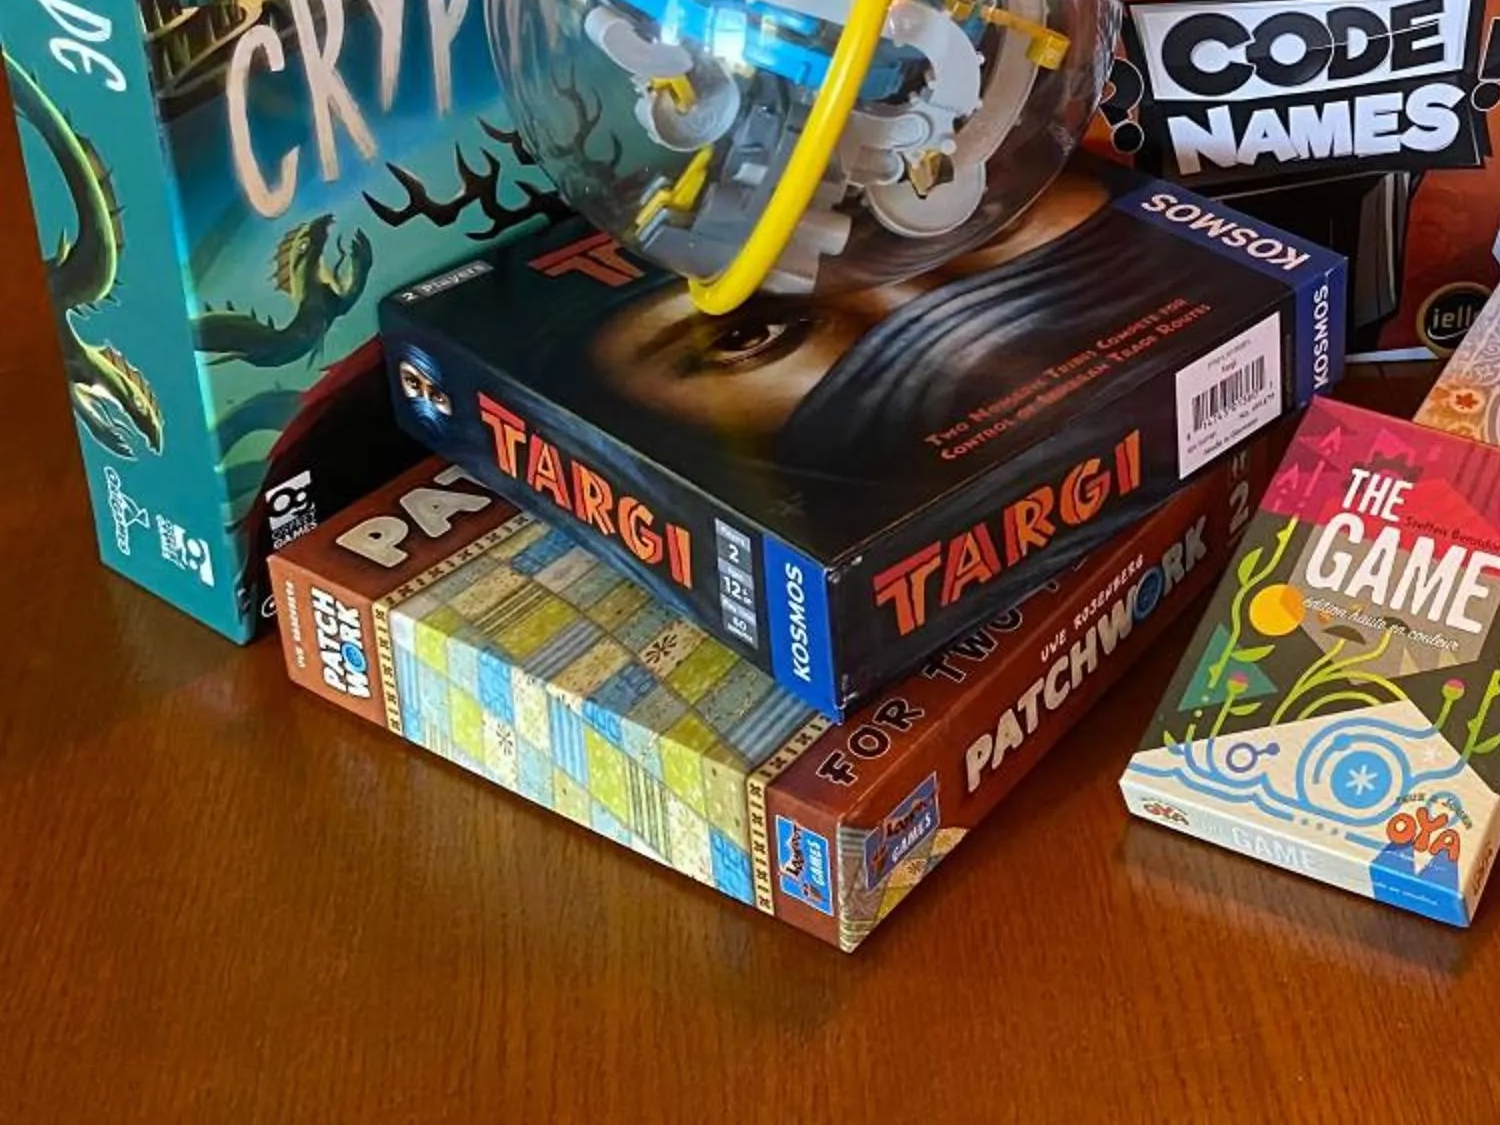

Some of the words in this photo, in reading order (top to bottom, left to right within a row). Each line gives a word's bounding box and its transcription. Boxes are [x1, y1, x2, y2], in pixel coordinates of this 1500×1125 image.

[1166, 82, 1466, 175] NAMES
[421, 262, 486, 293] Players
[1142, 192, 1309, 271] KOSMOS
[1312, 281, 1331, 391] KOSMOS
[1432, 305, 1480, 329] iell
[941, 418, 1014, 461] CONTROL
[1156, 303, 1213, 336] ROUTES
[477, 391, 692, 591] TARGI
[873, 428, 1142, 636] TARGI
[1342, 467, 1414, 523] THE
[728, 544, 741, 564] 2
[310, 586, 347, 693] PATCH
[785, 562, 812, 682] KOSMOS
[965, 514, 1208, 793] PATCHWORK
[1040, 634, 1068, 663] UWE
[1073, 553, 1144, 628] ROSENBERG
[1348, 606, 1388, 632] haute
[1388, 623, 1406, 636] en
[1407, 625, 1460, 653] couleur
[817, 696, 925, 787] FOR
[1230, 826, 1324, 873] GAME
[1386, 806, 1461, 863] OYA
